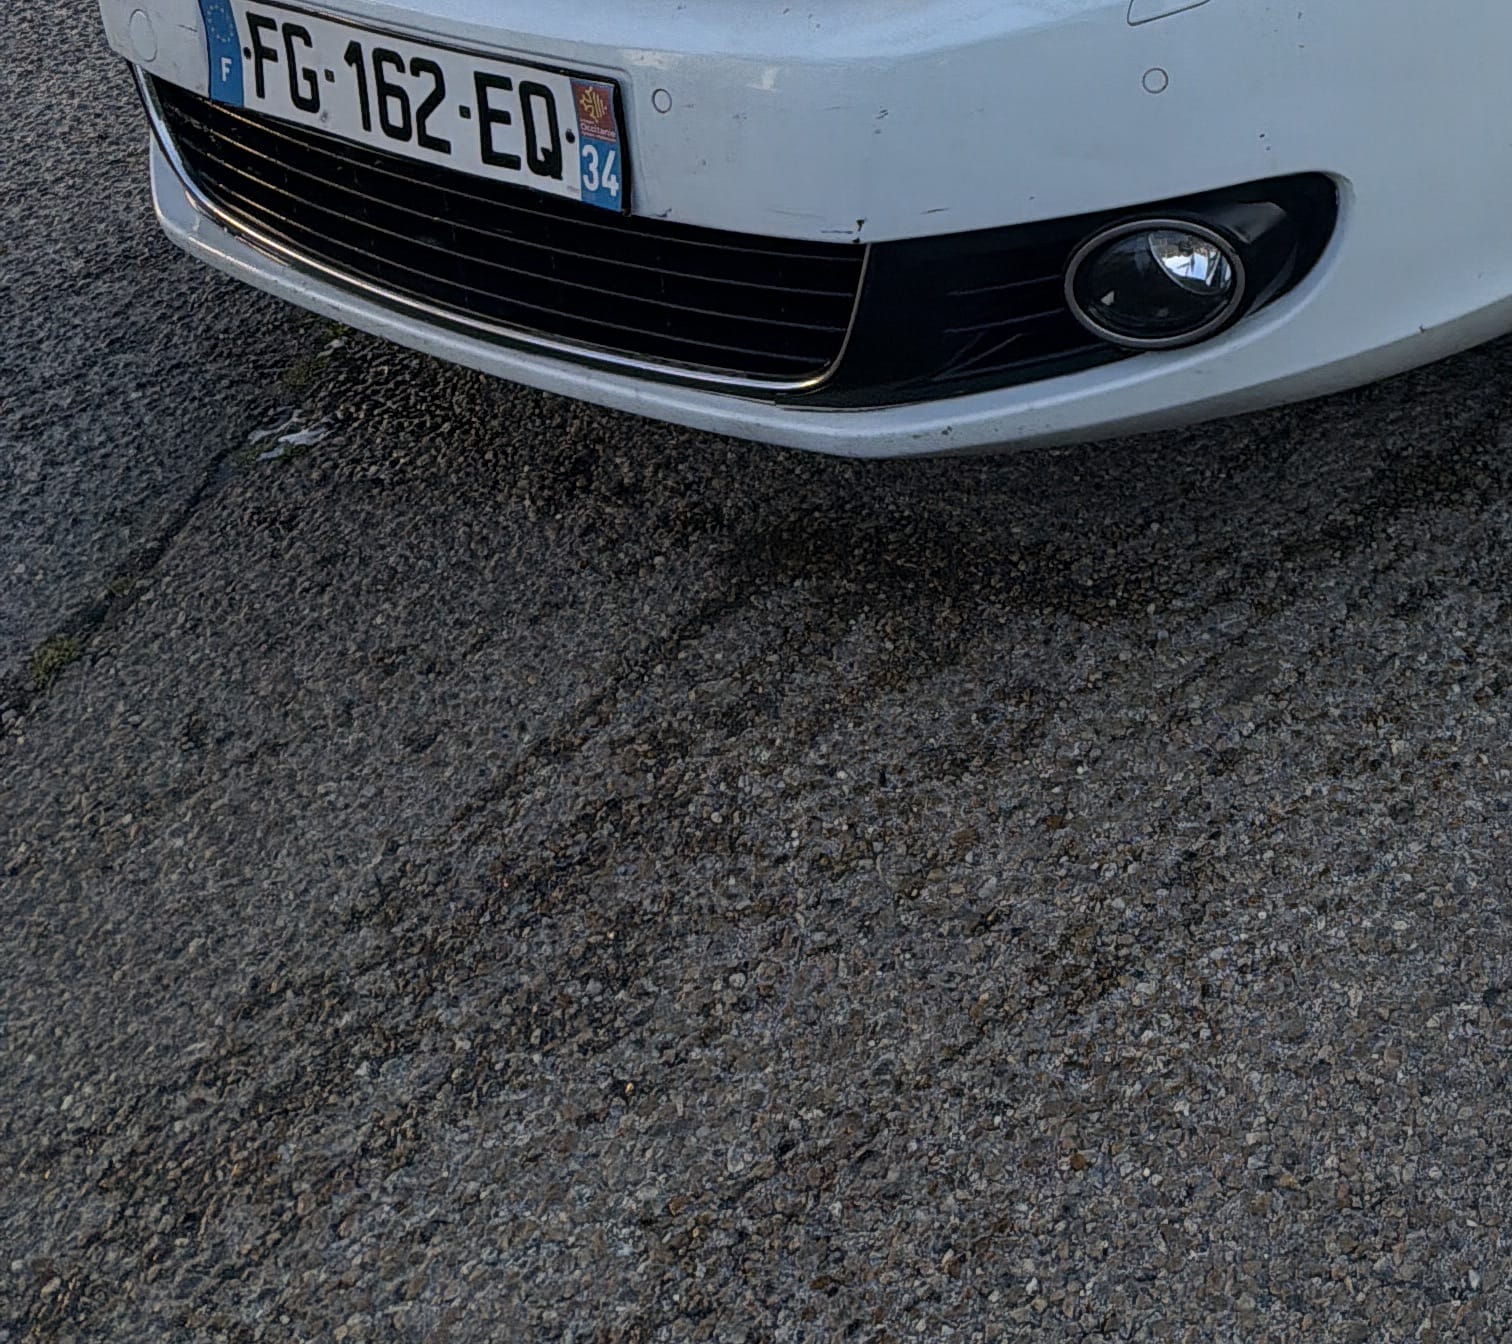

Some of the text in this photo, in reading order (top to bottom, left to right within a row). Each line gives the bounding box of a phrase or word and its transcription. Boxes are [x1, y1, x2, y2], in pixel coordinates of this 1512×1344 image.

[221, 57, 232, 82] F
[246, 11, 563, 180] FG-162-EQ
[582, 144, 619, 197] 34
